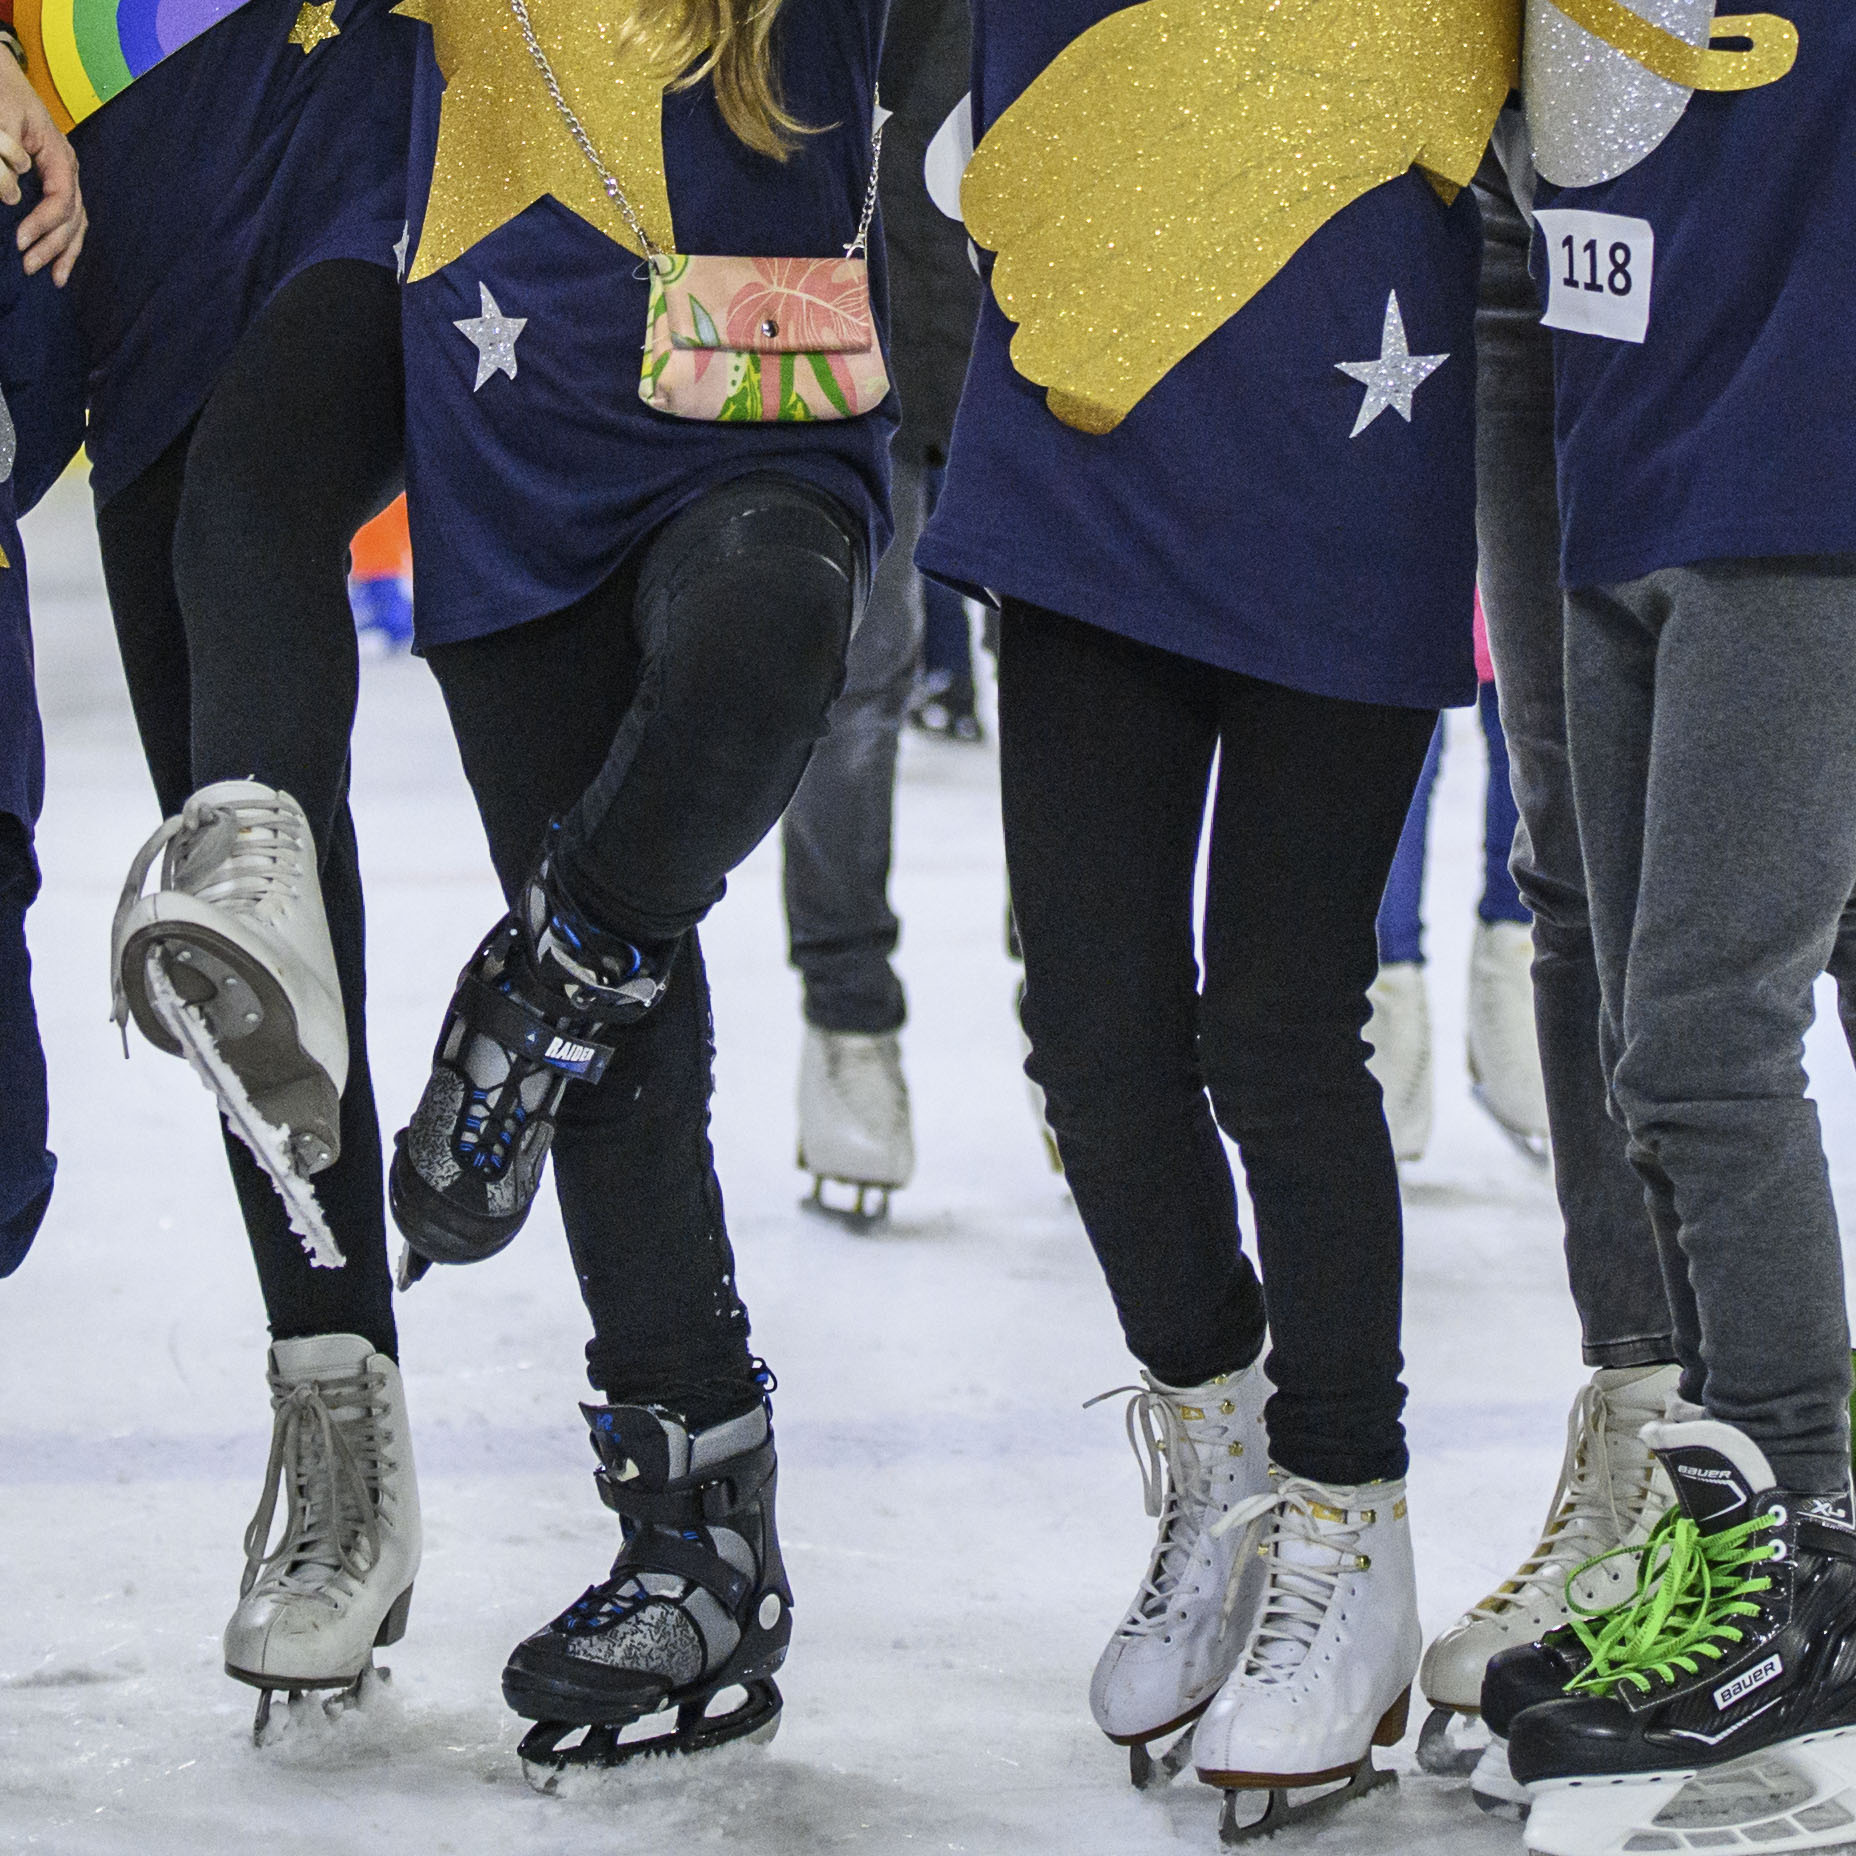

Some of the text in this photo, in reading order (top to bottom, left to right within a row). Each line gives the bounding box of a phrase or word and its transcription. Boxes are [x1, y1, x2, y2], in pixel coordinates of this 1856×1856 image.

[1561, 234, 1633, 297] 118
[1678, 1464, 1732, 1479] BAUER
[1720, 1661, 1776, 1703] BAUER
